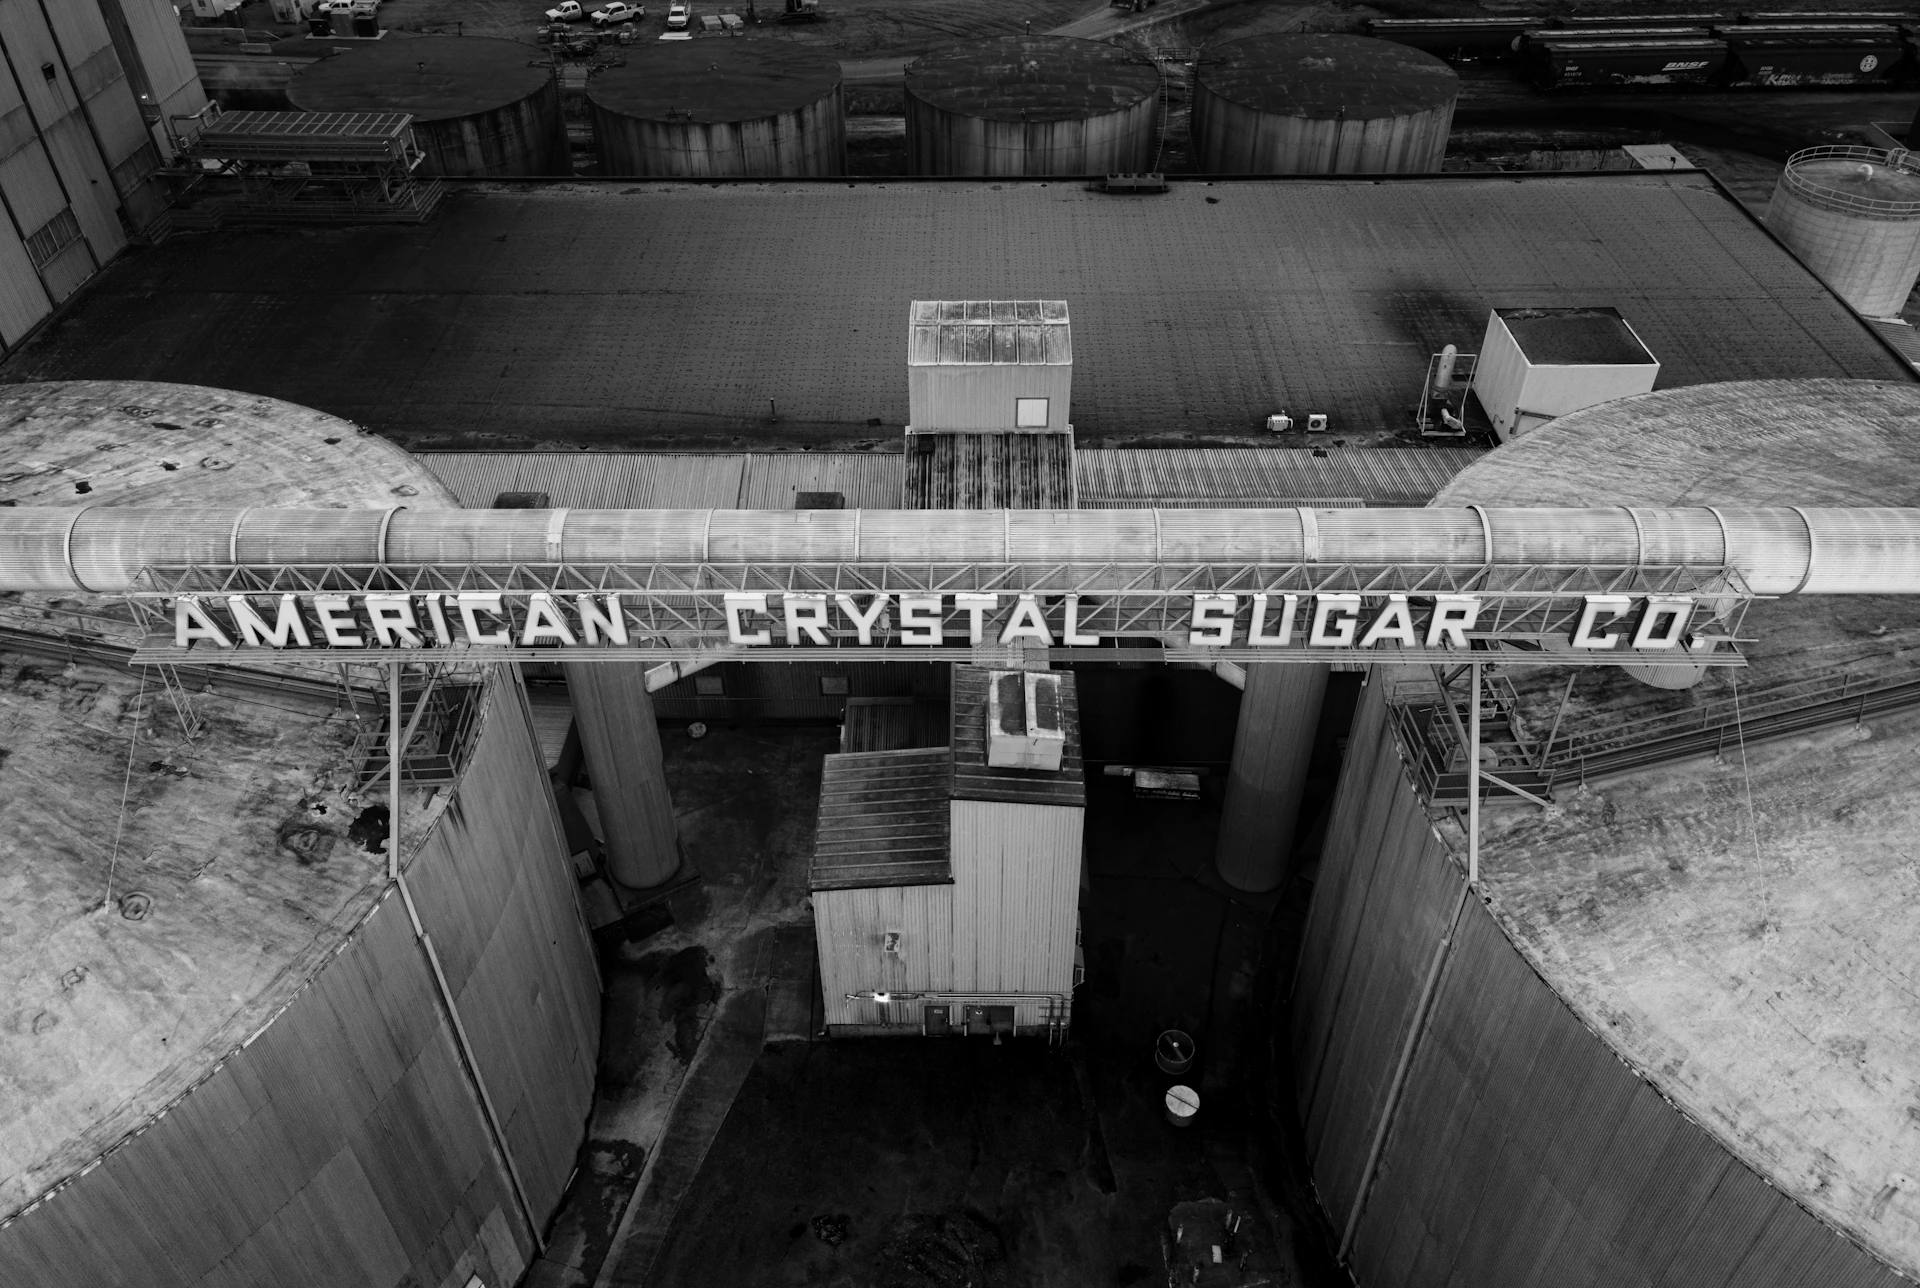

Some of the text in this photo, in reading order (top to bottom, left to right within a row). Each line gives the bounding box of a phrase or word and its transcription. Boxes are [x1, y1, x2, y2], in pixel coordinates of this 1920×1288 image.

[175, 595, 630, 647] AMERICAN
[724, 594, 1100, 646] CRYSTAL
[1188, 594, 1481, 647] SUGAR
